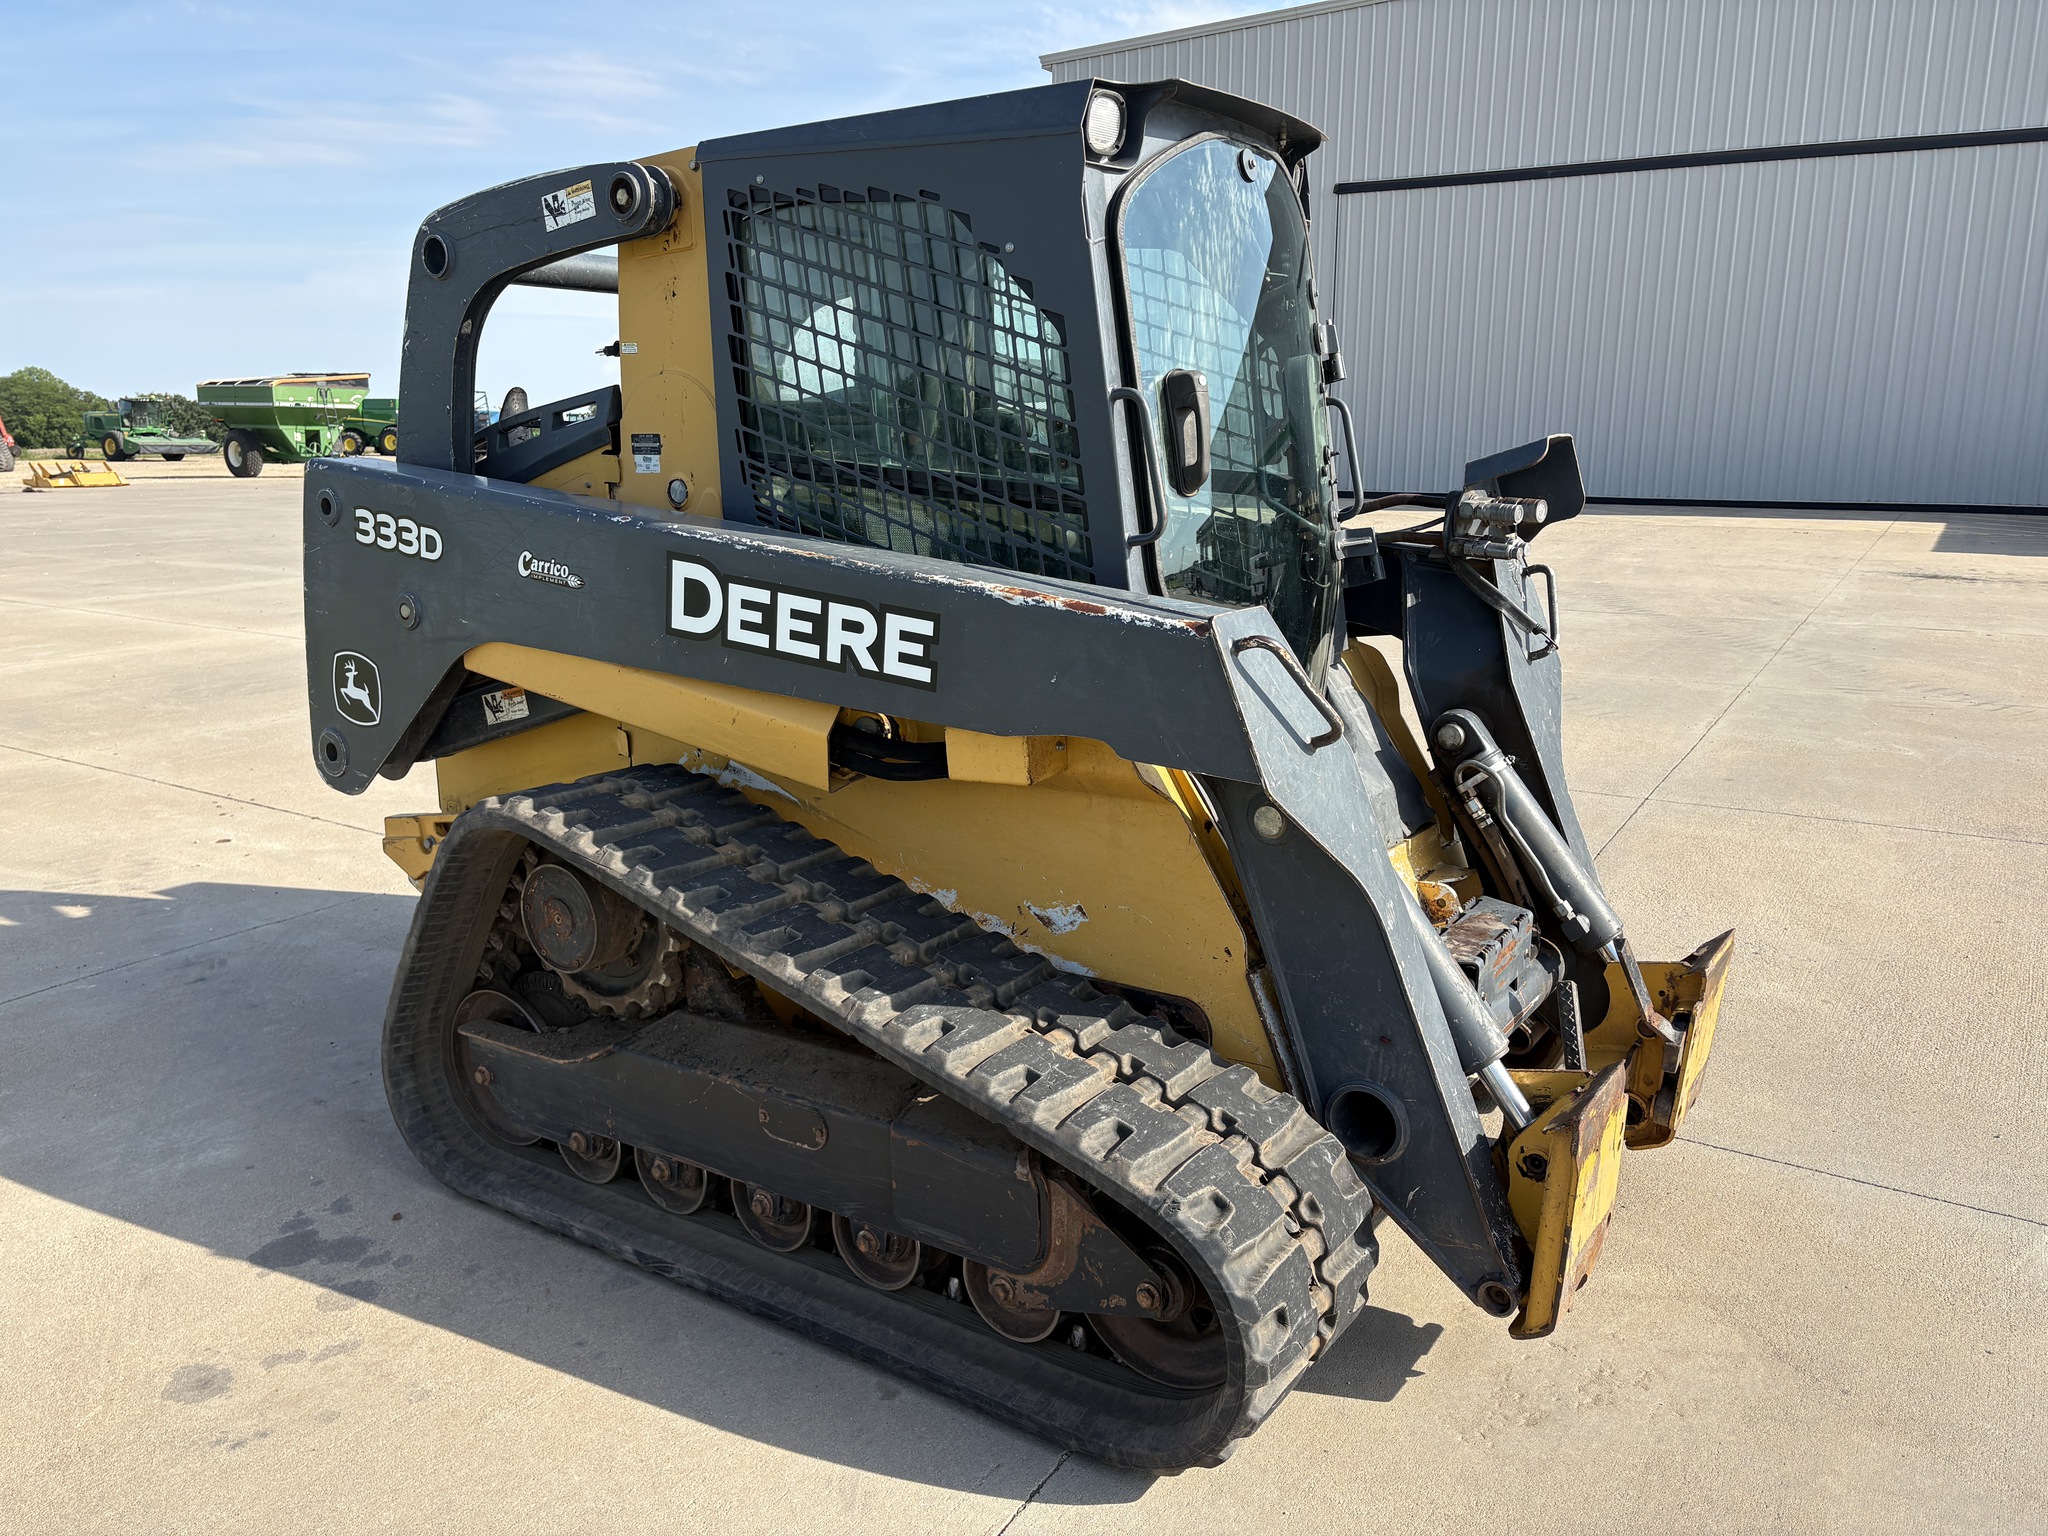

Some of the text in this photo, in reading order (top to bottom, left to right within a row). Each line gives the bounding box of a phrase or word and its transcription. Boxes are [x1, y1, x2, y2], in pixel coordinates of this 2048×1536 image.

[355, 508, 443, 561] 333D
[518, 550, 569, 578] Carrico
[530, 574, 567, 586] IMPLEMENT
[671, 559, 935, 683] DEERE
